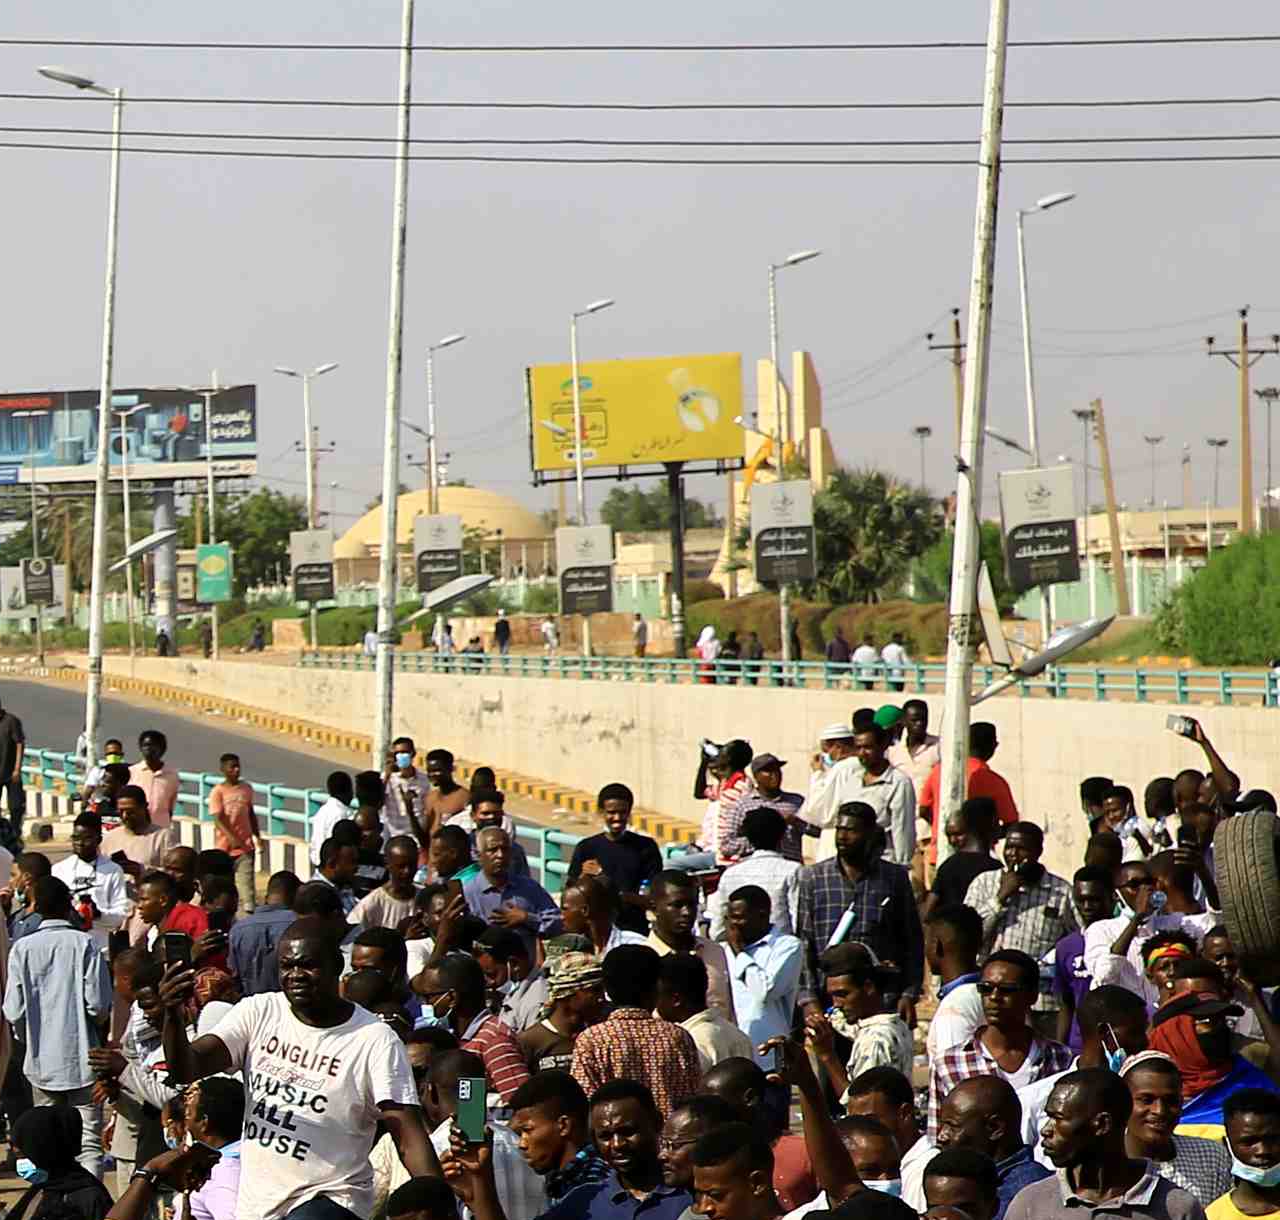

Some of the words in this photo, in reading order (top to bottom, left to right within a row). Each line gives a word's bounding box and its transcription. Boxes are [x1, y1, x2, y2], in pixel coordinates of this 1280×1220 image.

[260, 1035, 340, 1077] ONGLIFE
[252, 1098, 297, 1132] ALL
[244, 1121, 311, 1161] OUSE
